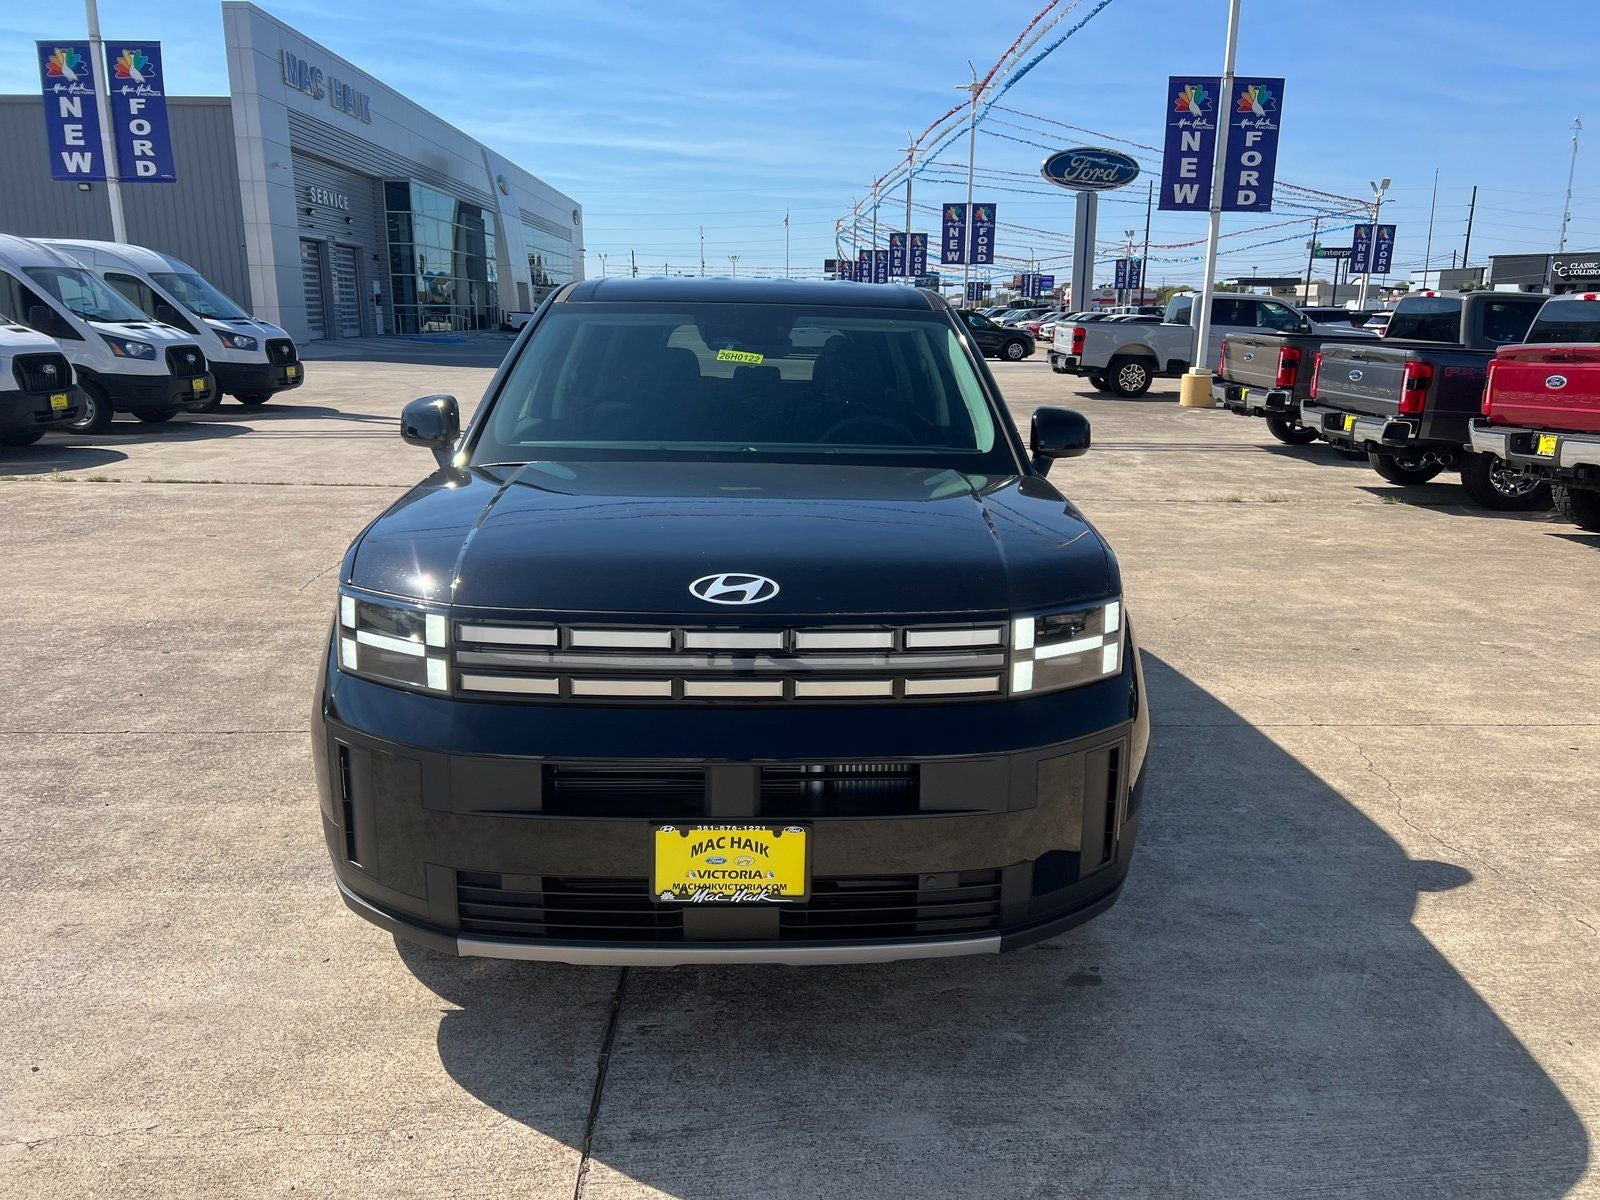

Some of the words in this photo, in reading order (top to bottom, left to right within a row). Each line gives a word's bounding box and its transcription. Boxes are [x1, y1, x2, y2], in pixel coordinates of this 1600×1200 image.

[280, 51, 325, 100] MAC
[59, 96, 92, 173] NEW
[129, 98, 157, 176] FORD
[1064, 157, 1119, 181] Ford
[1173, 131, 1201, 204] NEW
[1236, 131, 1262, 205] FORD
[310, 186, 350, 211] SERVICE
[947, 227, 960, 262] NEW
[977, 227, 988, 262] FORD
[1317, 249, 1352, 257] enterpr
[1354, 243, 1366, 271] NEW
[892, 250, 902, 275] NEW
[914, 250, 922, 275] FORD
[1377, 244, 1388, 272] FORD
[719, 352, 761, 362] 26H0122
[690, 836, 726, 858] MAC
[730, 836, 770, 858] HAIK
[672, 883, 787, 891] MACHAIKVICTORIA.COM
[697, 870, 763, 879] VICTORIA
[690, 888, 729, 902] Mac
[730, 888, 772, 902] Haik
